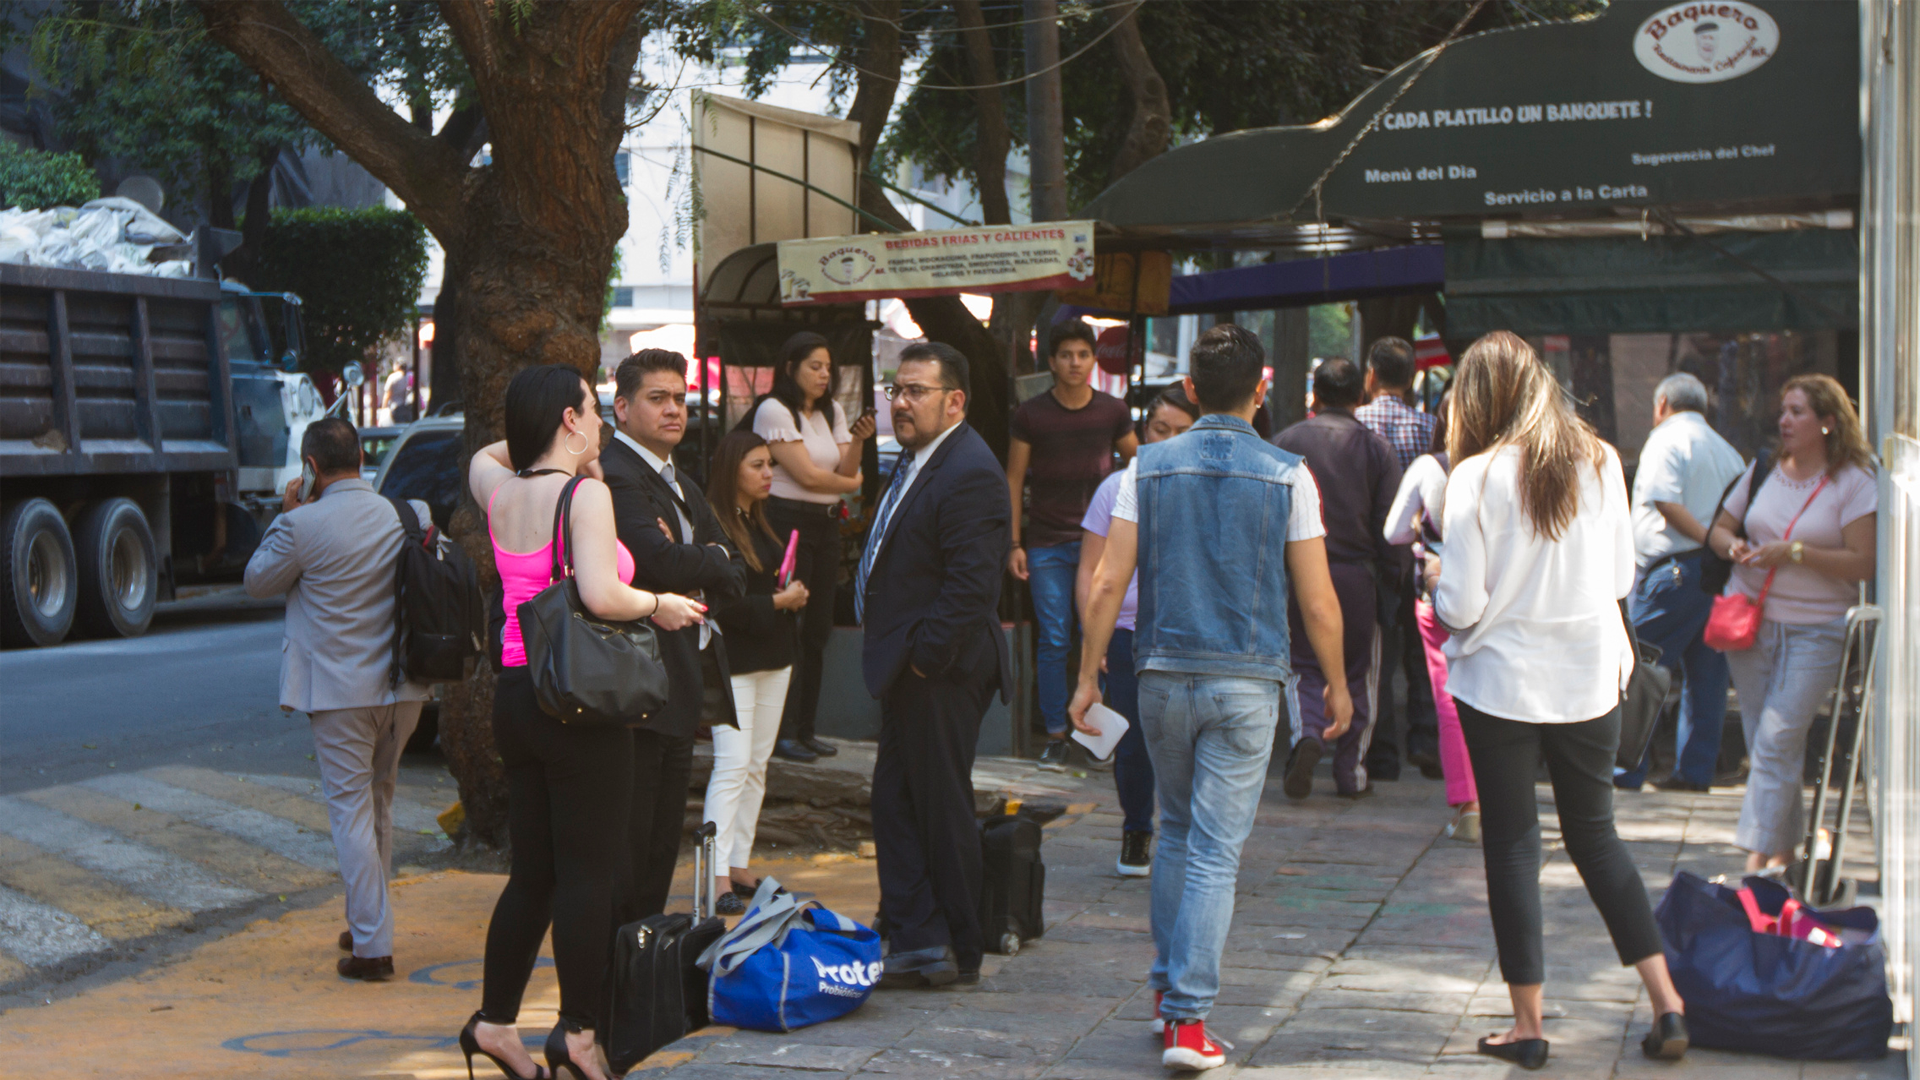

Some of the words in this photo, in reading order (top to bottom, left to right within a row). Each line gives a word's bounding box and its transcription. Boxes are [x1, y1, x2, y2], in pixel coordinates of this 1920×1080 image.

[1644, 4, 1759, 40] Baquero
[1383, 111, 1430, 130] CADA
[1433, 106, 1514, 127] PLATILLO
[1517, 104, 1542, 123] UN
[1546, 100, 1641, 122] BANQUETE
[1645, 100, 1653, 119] !
[1631, 148, 1712, 167] Sugerencia
[1715, 146, 1738, 160] del
[1740, 143, 1775, 158] Chef
[1416, 165, 1443, 181] del
[1484, 188, 1556, 206] Servicio
[1561, 189, 1572, 201] a
[1576, 186, 1594, 200] la
[1598, 184, 1648, 199] Carta
[885, 238, 938, 250] BEBIDAS
[942, 235, 978, 246] FRIAS
[982, 234, 990, 243] Y
[994, 229, 1065, 242] CALIENTES
[819, 247, 876, 266] Baquero
